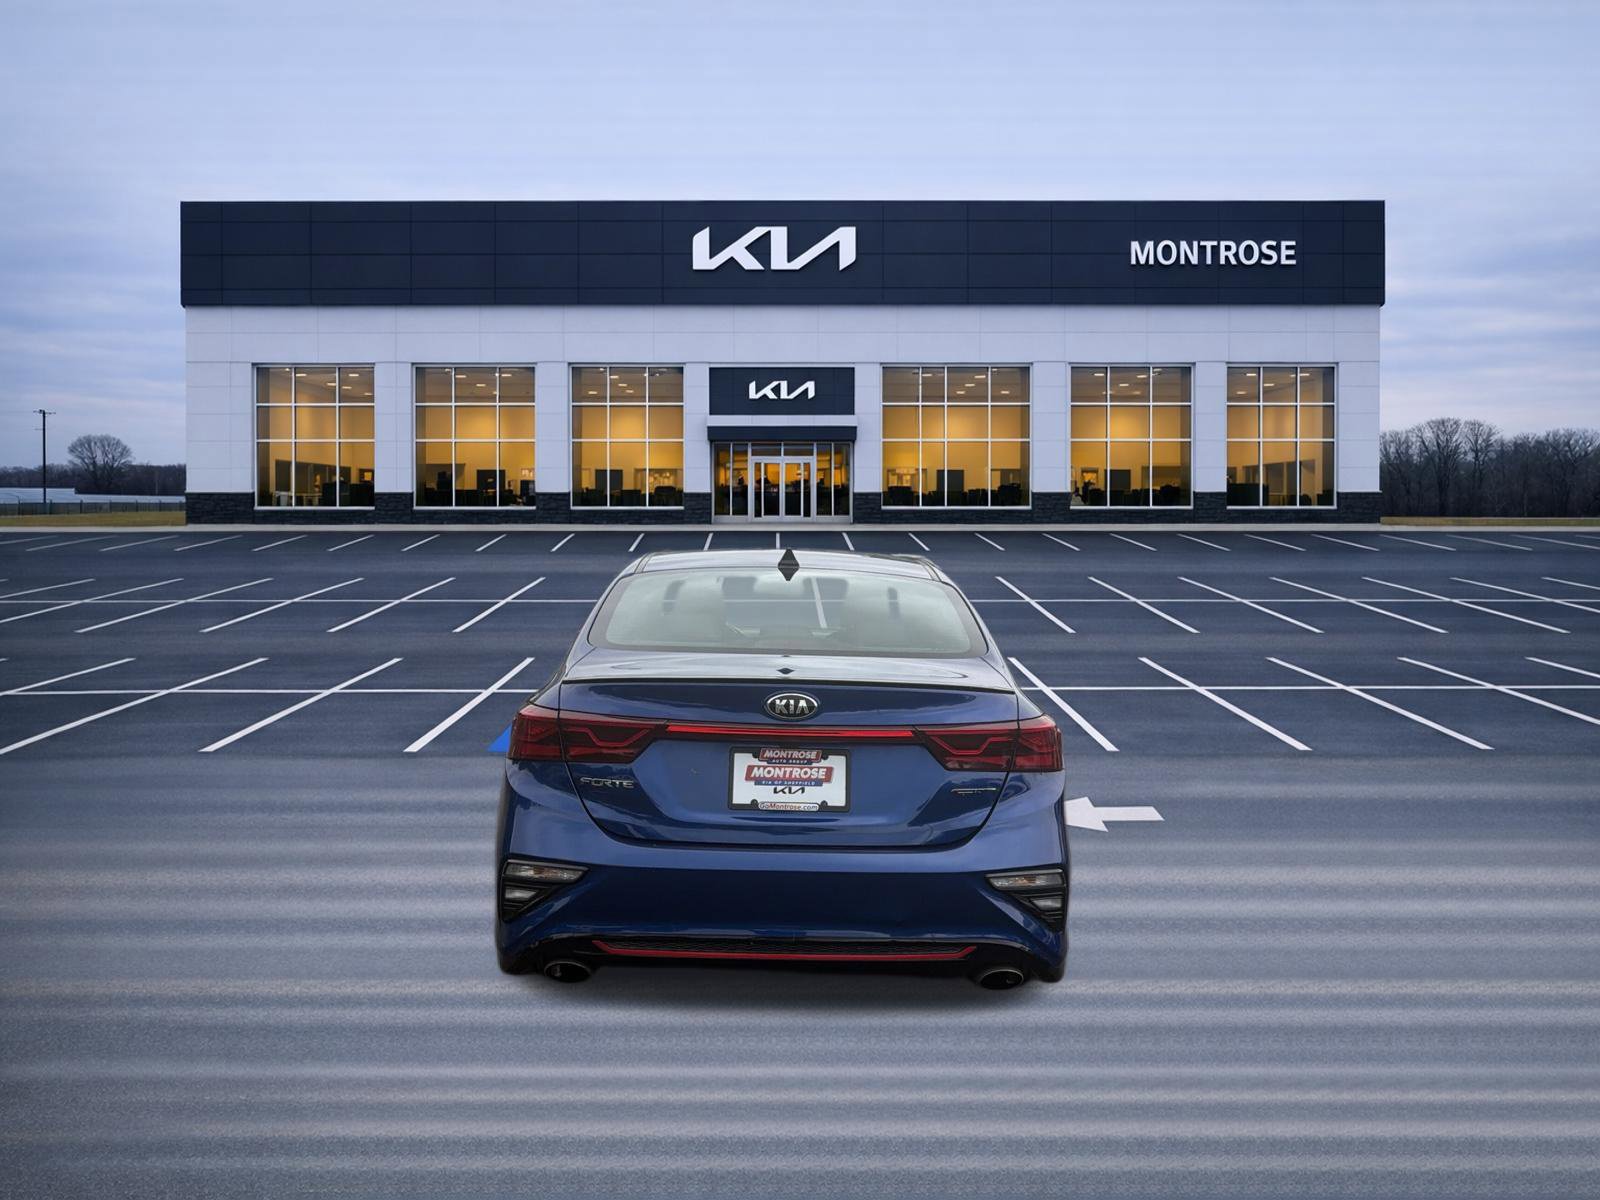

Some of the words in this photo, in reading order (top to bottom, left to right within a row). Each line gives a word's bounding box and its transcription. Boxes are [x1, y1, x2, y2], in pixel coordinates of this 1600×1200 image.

[692, 226, 856, 271] KIA
[1130, 240, 1297, 266] MONTROSE
[749, 380, 815, 399] KIA
[775, 699, 809, 714] KIA
[764, 750, 817, 759] MONTROSE
[750, 766, 827, 779] MONTROSE
[580, 777, 634, 789] FORTE
[773, 786, 805, 795] KIA
[759, 802, 818, 811] GoMontrose.com
